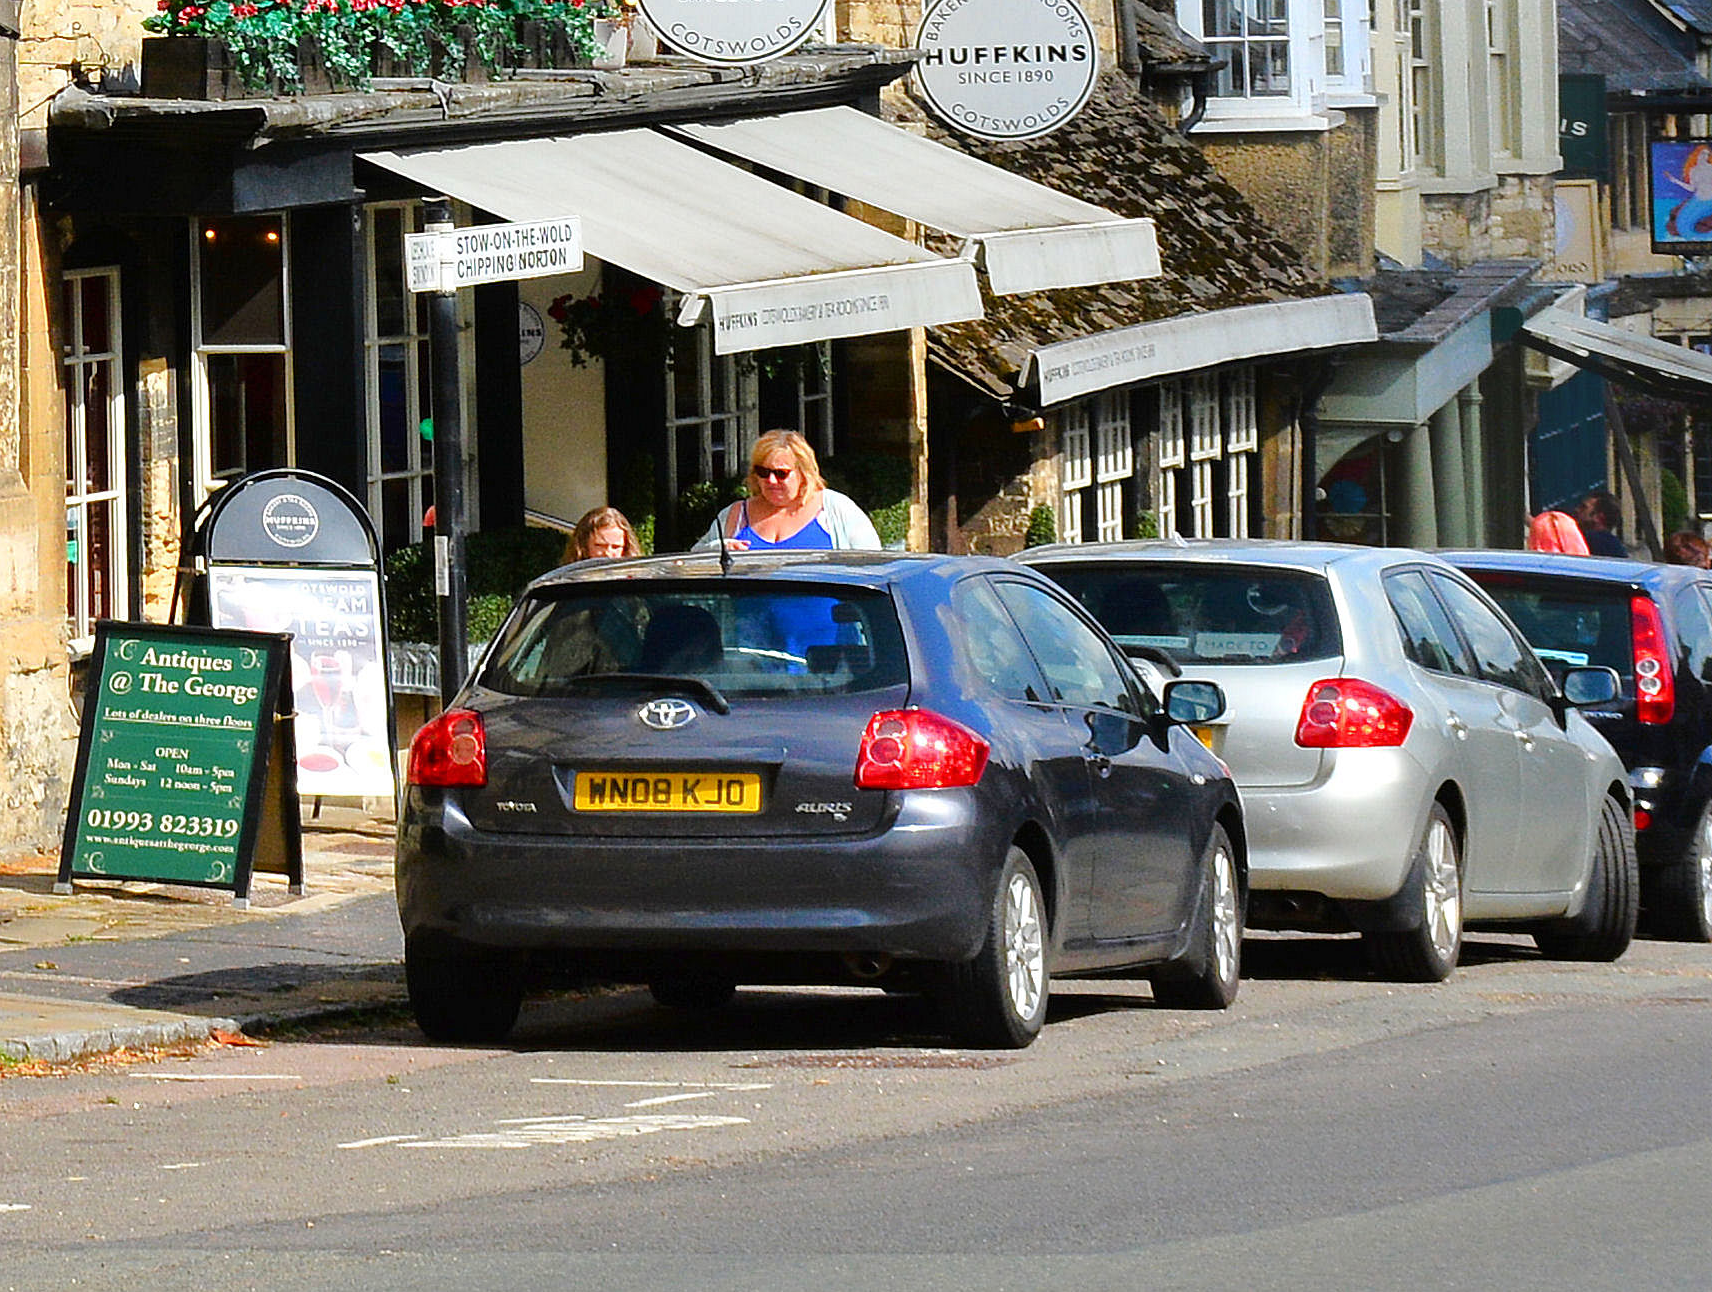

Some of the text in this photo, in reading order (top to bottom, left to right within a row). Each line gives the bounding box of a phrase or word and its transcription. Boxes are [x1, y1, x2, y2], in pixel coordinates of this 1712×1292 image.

[671, 16, 802, 55] COTSWOLDS
[925, 45, 1087, 65] HUFFKINS
[958, 70, 1054, 84] SINCE 1890
[951, 97, 1069, 131] COTSWOLDS
[457, 224, 572, 255] STOW-ON-THE-WOLD
[457, 254, 514, 278] CHIPPING
[519, 248, 567, 271] NORTON
[301, 584, 366, 595] OTSWOLD
[298, 618, 369, 637] TEAS
[140, 647, 232, 675] Antiques
[109, 671, 258, 705] @ The George
[105, 707, 253, 728] Lots of dealers on three floors
[155, 747, 189, 760] OPEN
[106, 758, 132, 770] Mon
[139, 760, 157, 771] Sat
[175, 763, 203, 775] 10am
[211, 766, 235, 779] 5pm
[104, 774, 147, 788] Sundays
[160, 777, 172, 789] 12
[174, 781, 201, 791] noon
[209, 782, 233, 794] 5pm
[589, 778, 744, 806] WN08 KJO
[496, 801, 537, 813] TOYOTA
[87, 809, 239, 838] 01993 823319
[85, 833, 235, 854] www.antiquesatthegeorge.com
